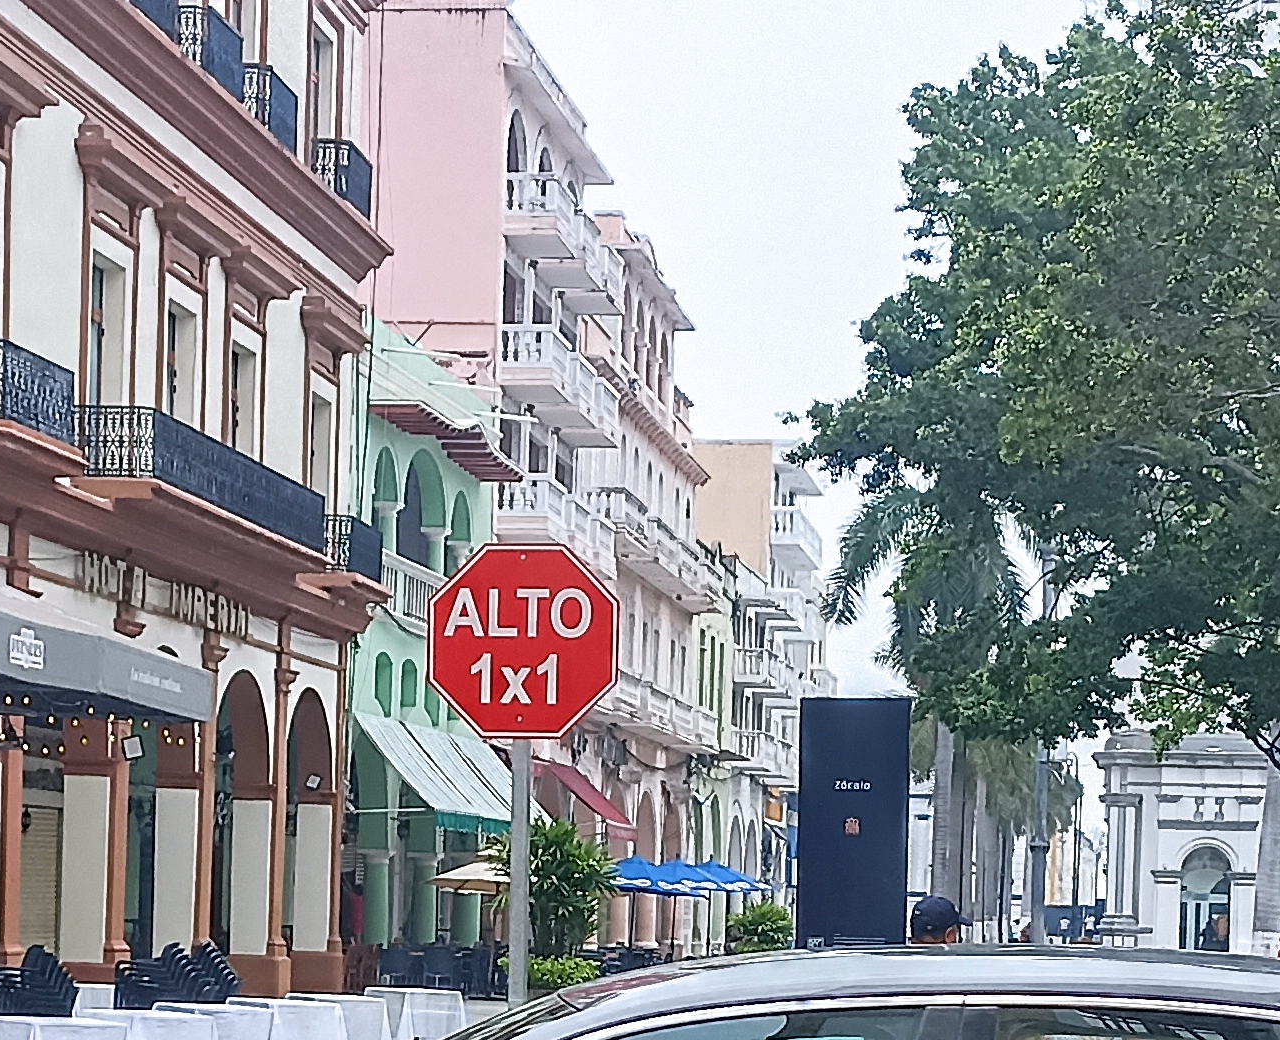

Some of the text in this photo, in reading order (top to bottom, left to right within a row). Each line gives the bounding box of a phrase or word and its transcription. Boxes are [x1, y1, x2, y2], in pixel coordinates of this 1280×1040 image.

[443, 587, 593, 638] ALTO
[470, 653, 559, 705] 1x1
[834, 779, 871, 790] Zócalo
